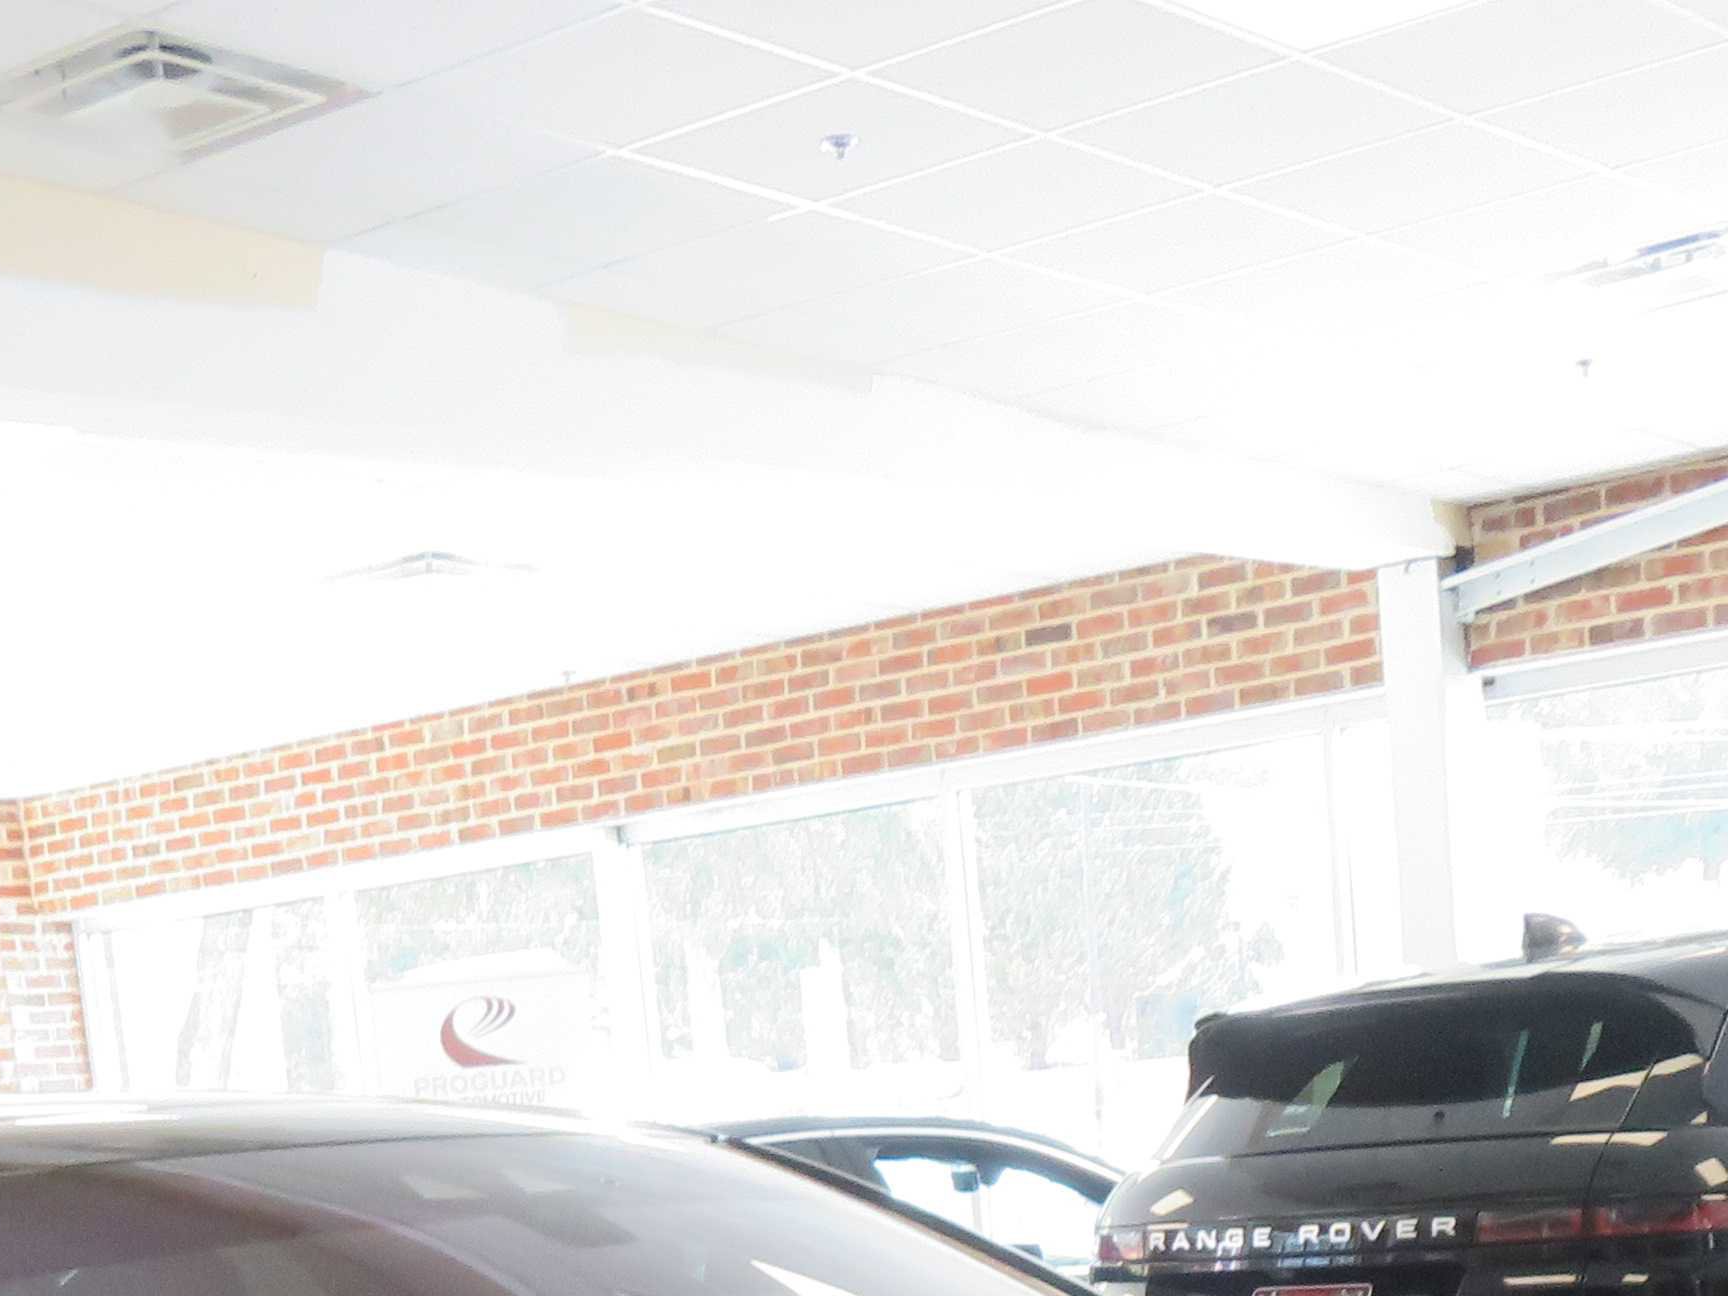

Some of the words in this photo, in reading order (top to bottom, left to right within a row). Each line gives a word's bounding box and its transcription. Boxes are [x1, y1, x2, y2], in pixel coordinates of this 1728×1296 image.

[414, 1065, 565, 1097] PROGUARD
[1148, 1226, 1272, 1252] RANGE
[1298, 1215, 1458, 1244] ROVER
